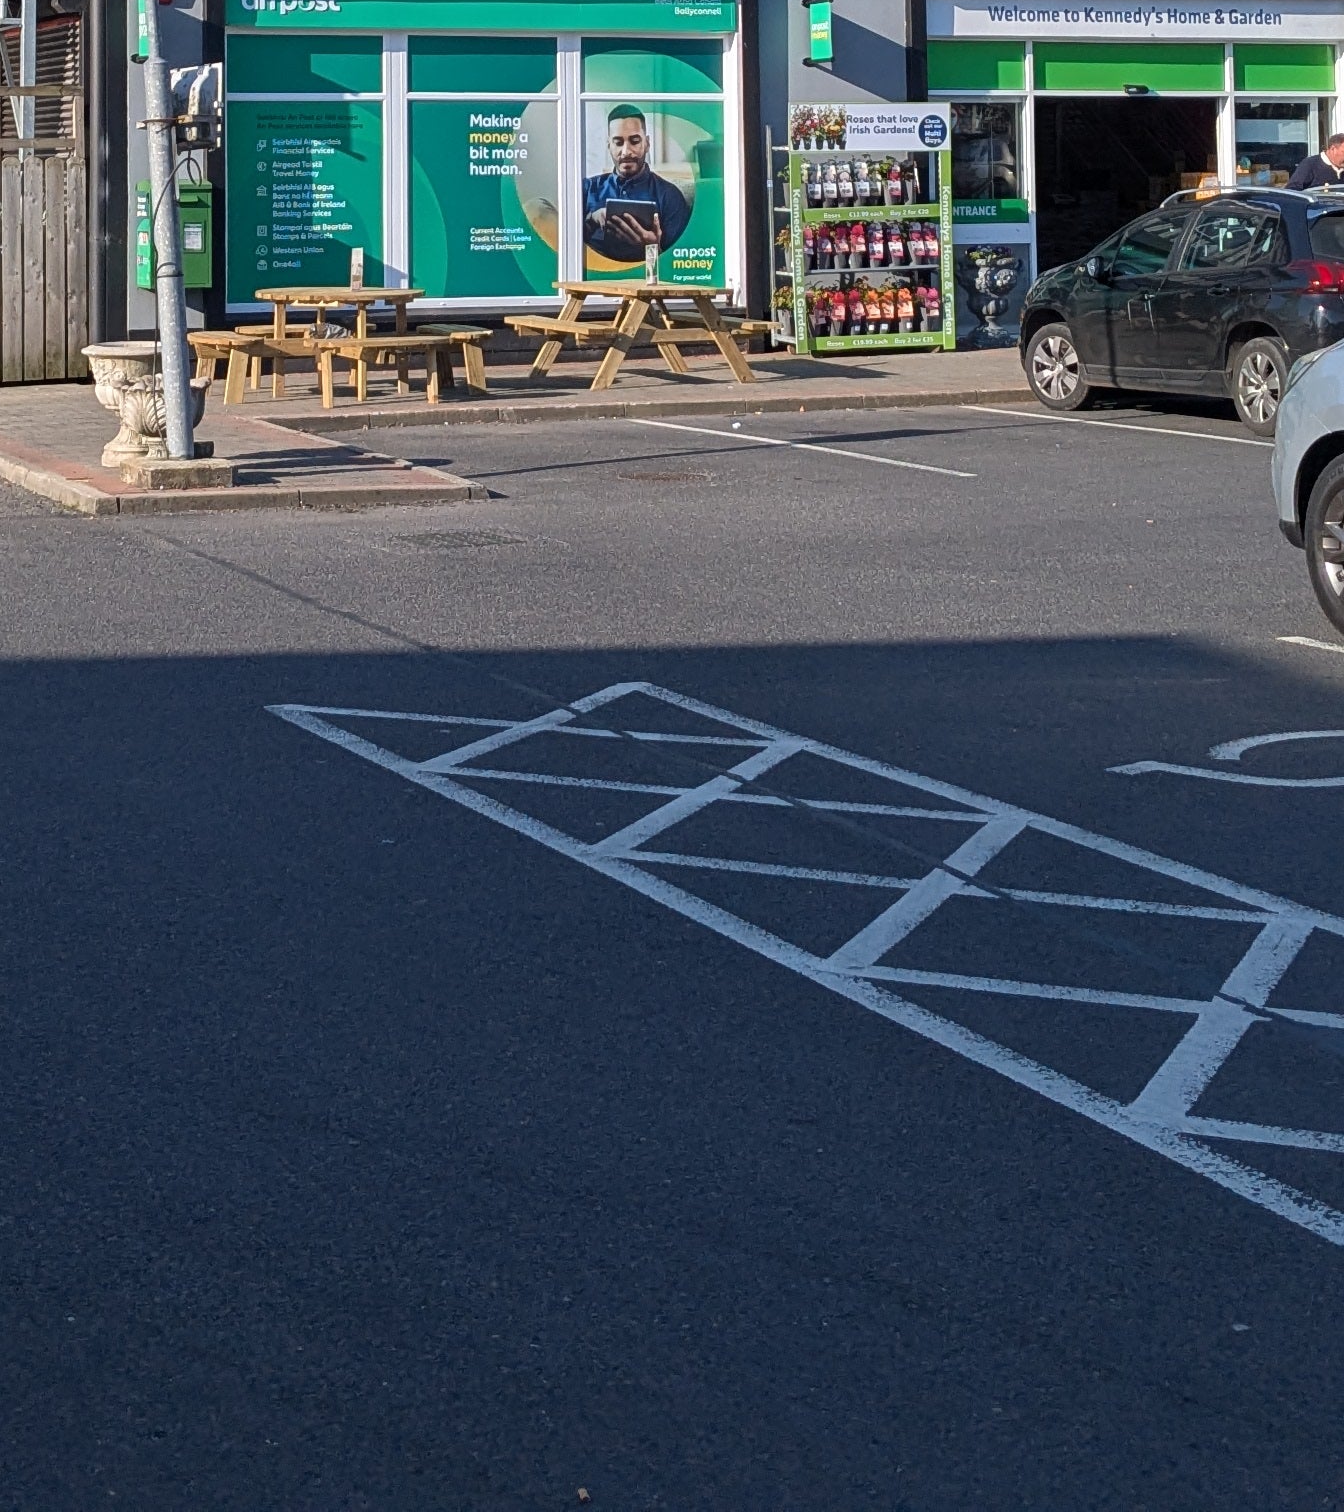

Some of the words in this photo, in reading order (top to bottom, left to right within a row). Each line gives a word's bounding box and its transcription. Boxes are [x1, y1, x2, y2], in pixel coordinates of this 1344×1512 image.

[674, 6, 722, 16] Ballyconnell
[988, 6, 1059, 22] Welcome
[1064, 7, 1080, 23] to
[1084, 6, 1164, 26] Kennedy's
[1167, 8, 1211, 24] Home
[1214, 9, 1225, 24] &
[1228, 9, 1282, 25] Garden
[469, 114, 521, 130] Making
[846, 115, 874, 123] Roses
[877, 115, 897, 123] that
[899, 115, 918, 123] love
[849, 125, 870, 134] Irish
[873, 125, 915, 134] Gardens!
[469, 133, 517, 145] money
[519, 133, 528, 143] a
[469, 146, 489, 159] bit
[492, 149, 528, 159] more
[469, 162, 523, 175] human.
[792, 189, 801, 245] Kennedys
[941, 186, 951, 241] Kennedys
[953, 206, 997, 216] NTRANCE
[673, 259, 713, 270] money
[795, 249, 803, 283] Home
[943, 244, 952, 278] Home
[796, 287, 804, 295] &
[944, 282, 953, 290] &
[797, 298, 805, 341] Garden
